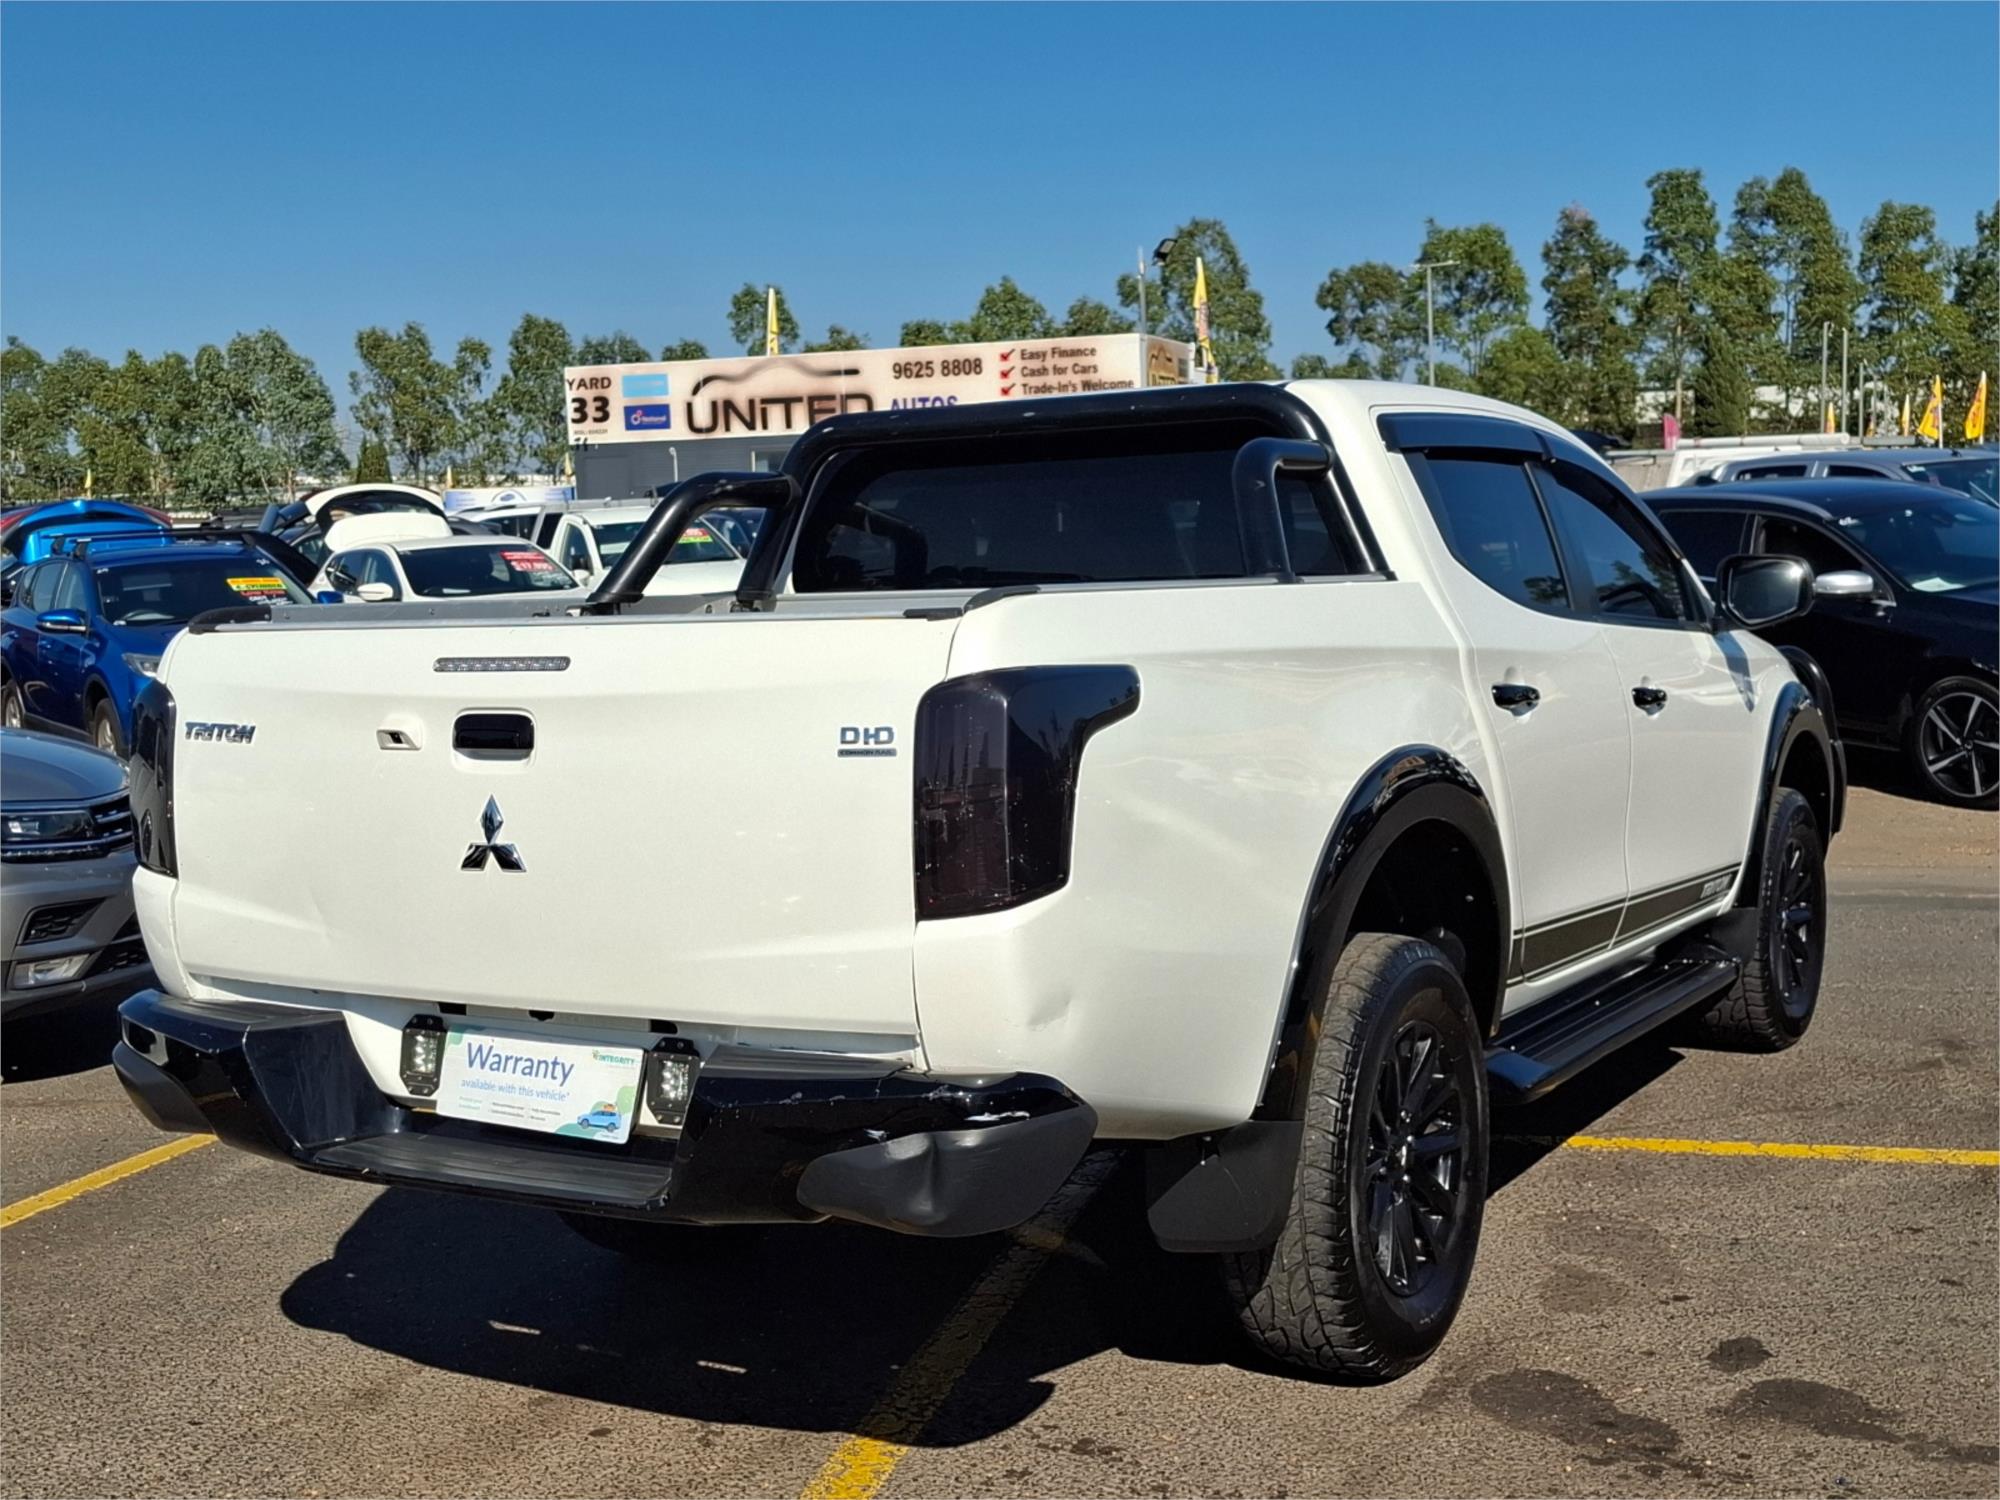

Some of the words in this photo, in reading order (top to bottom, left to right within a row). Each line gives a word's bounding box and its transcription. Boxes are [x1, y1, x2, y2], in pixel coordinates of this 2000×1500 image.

[1020, 348, 1047, 362] Easy
[1051, 346, 1097, 359] Finance
[892, 361, 935, 380] 9625
[941, 358, 983, 377] 8808
[1020, 365, 1048, 378] Cash
[1052, 364, 1068, 376] for
[1071, 362, 1099, 375] Cars
[566, 376, 612, 391] YARD
[1021, 380, 1078, 395] Trade-In's
[1081, 378, 1135, 392] Welcome
[570, 396, 610, 424] 33
[184, 721, 256, 745] TRITON
[466, 1041, 575, 1087] Warranty
[598, 1053, 636, 1065] INTEGRITY
[460, 1078, 497, 1092] available
[498, 1082, 517, 1095] with
[518, 1085, 534, 1098] this
